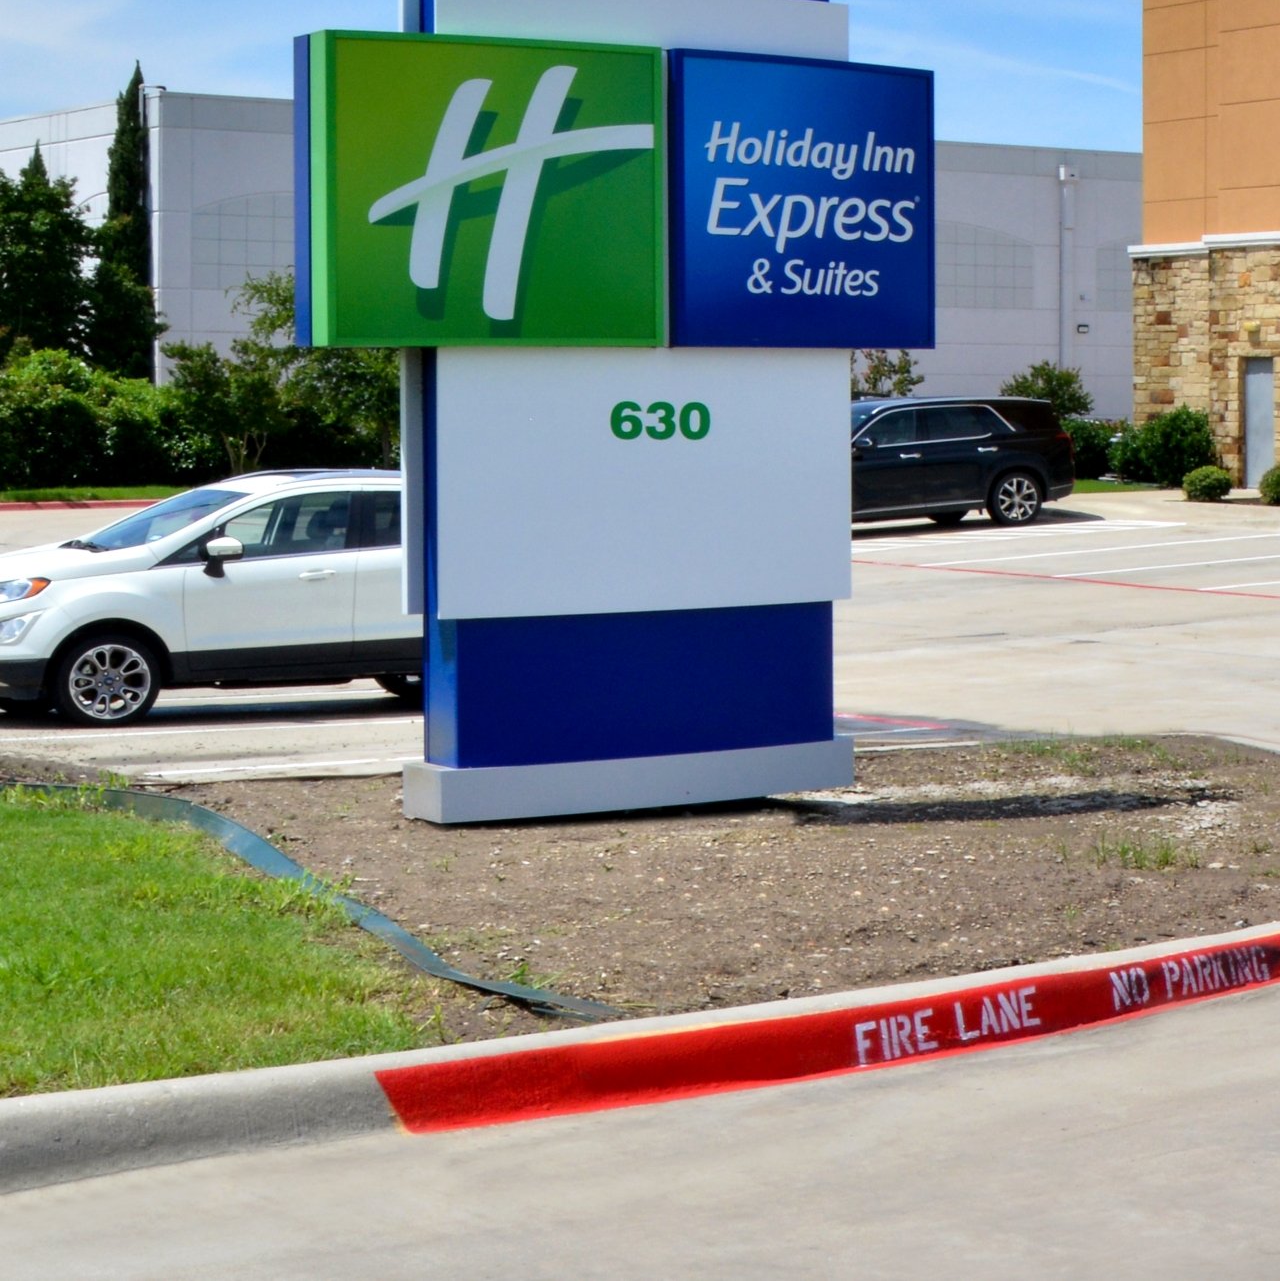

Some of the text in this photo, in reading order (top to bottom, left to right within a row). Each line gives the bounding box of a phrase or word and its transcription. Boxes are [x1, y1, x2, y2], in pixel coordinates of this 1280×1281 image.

[704, 120, 916, 180] Holiday Inn
[706, 177, 916, 254] Express
[746, 258, 880, 296] & Suites
[609, 401, 712, 441] 630
[854, 944, 1271, 1065] FIRE LANE NO PARKING
